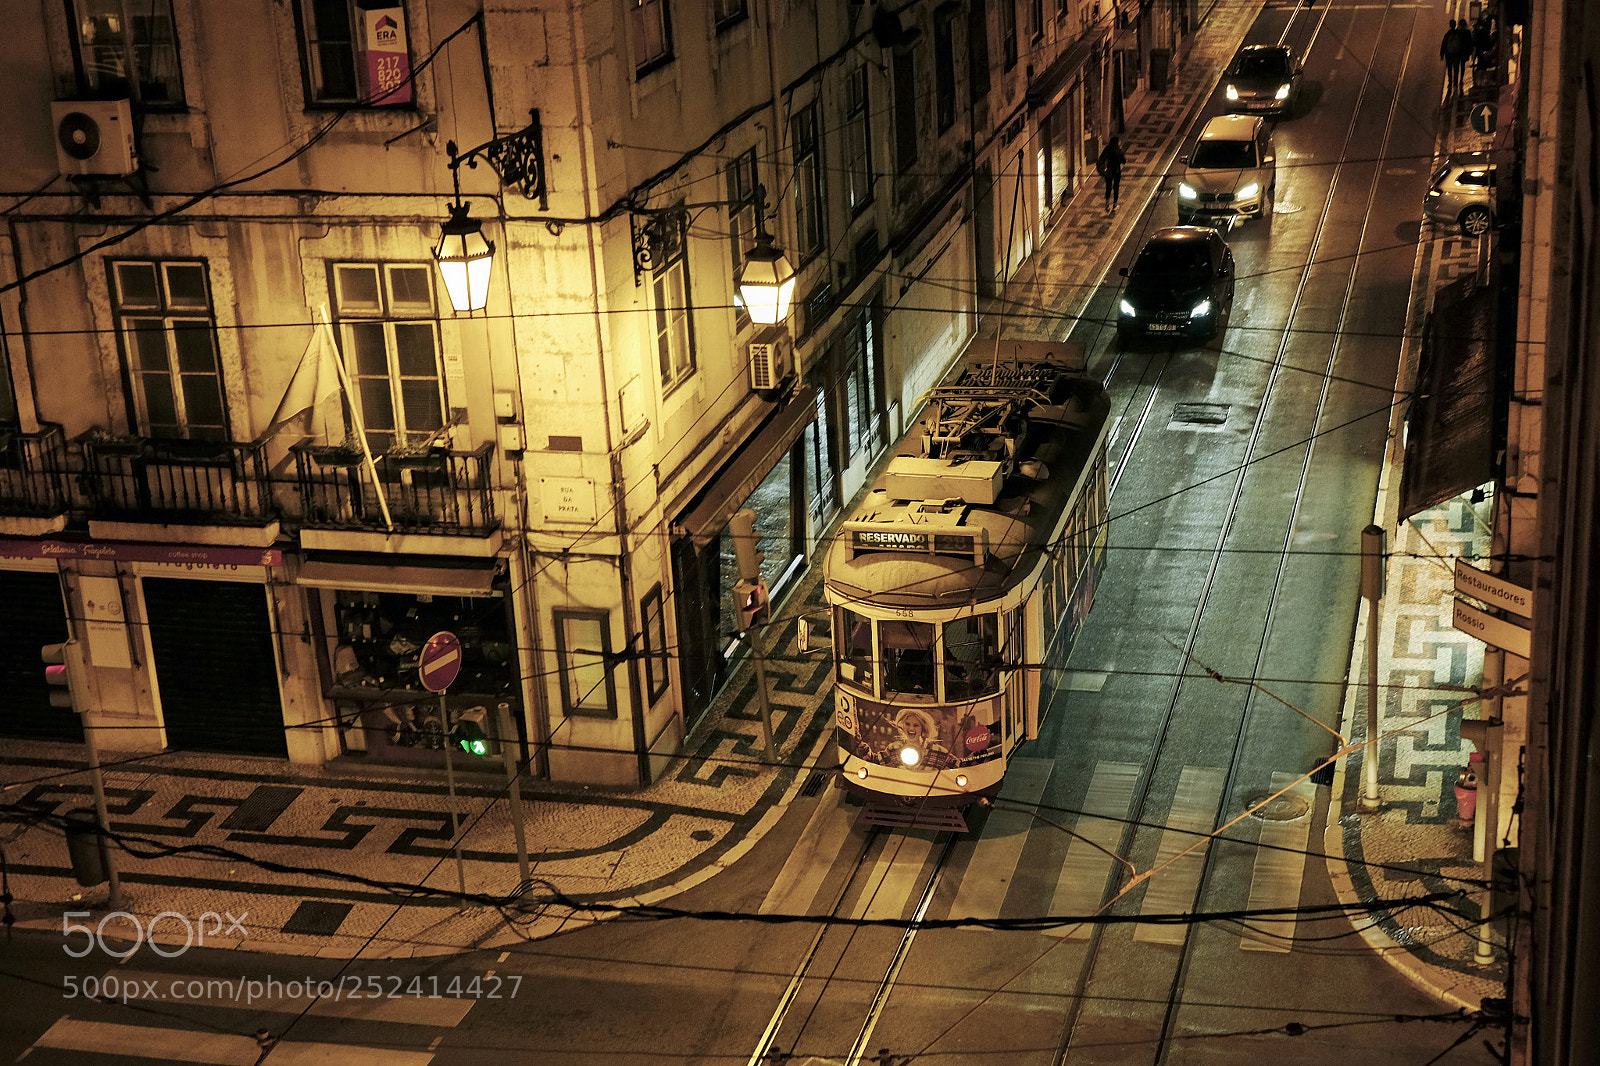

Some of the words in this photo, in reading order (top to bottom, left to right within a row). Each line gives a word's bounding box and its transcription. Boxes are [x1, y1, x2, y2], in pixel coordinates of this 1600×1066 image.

[376, 30, 397, 40] ERA
[377, 56, 400, 70] 217
[378, 68, 402, 82] 820
[859, 532, 925, 544] RESERVADO
[168, 551, 189, 559] coffee
[190, 552, 208, 560] shop
[1457, 568, 1526, 606] Restauradores
[1456, 608, 1486, 631] Rossio
